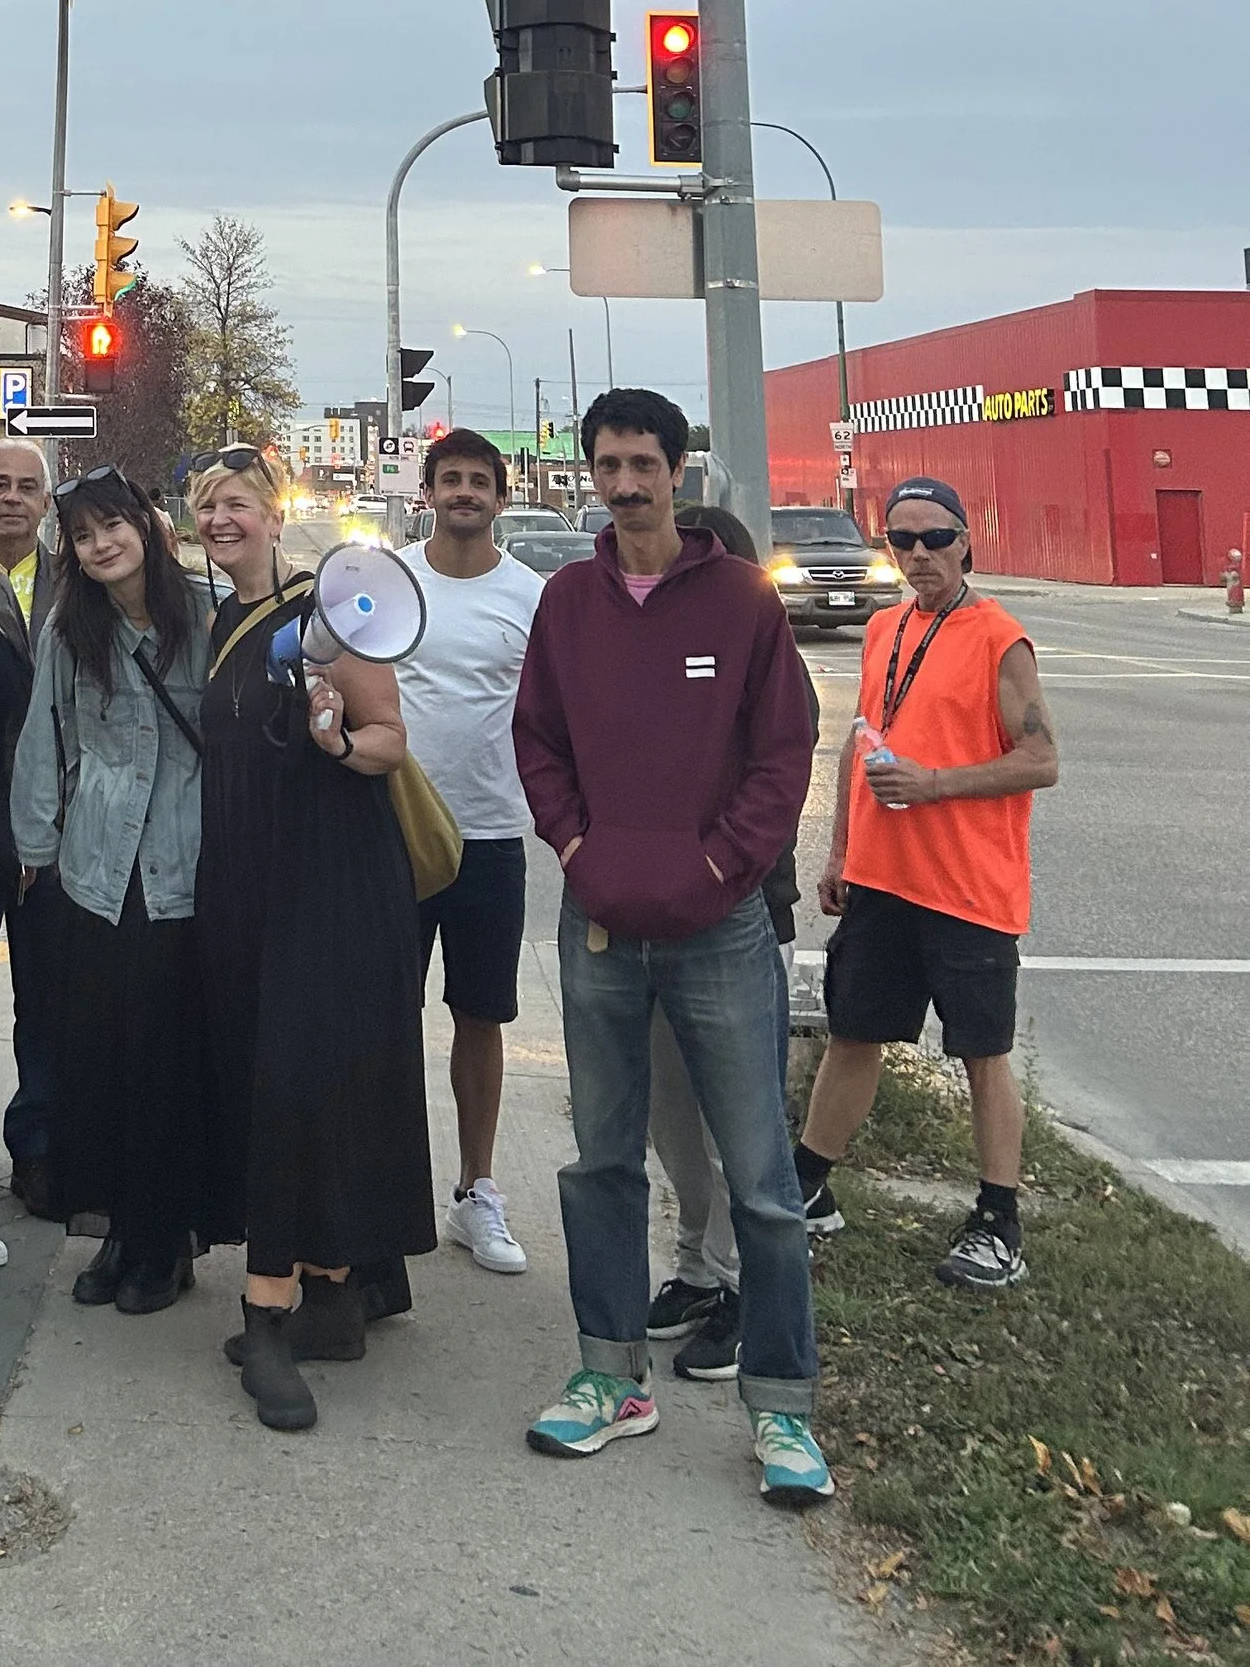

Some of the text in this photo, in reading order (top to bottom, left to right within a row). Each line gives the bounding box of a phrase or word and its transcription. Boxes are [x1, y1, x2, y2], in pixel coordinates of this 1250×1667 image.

[6, 375, 26, 400] P
[982, 387, 1048, 421] AUTO PARTS
[835, 431, 851, 440] 62
